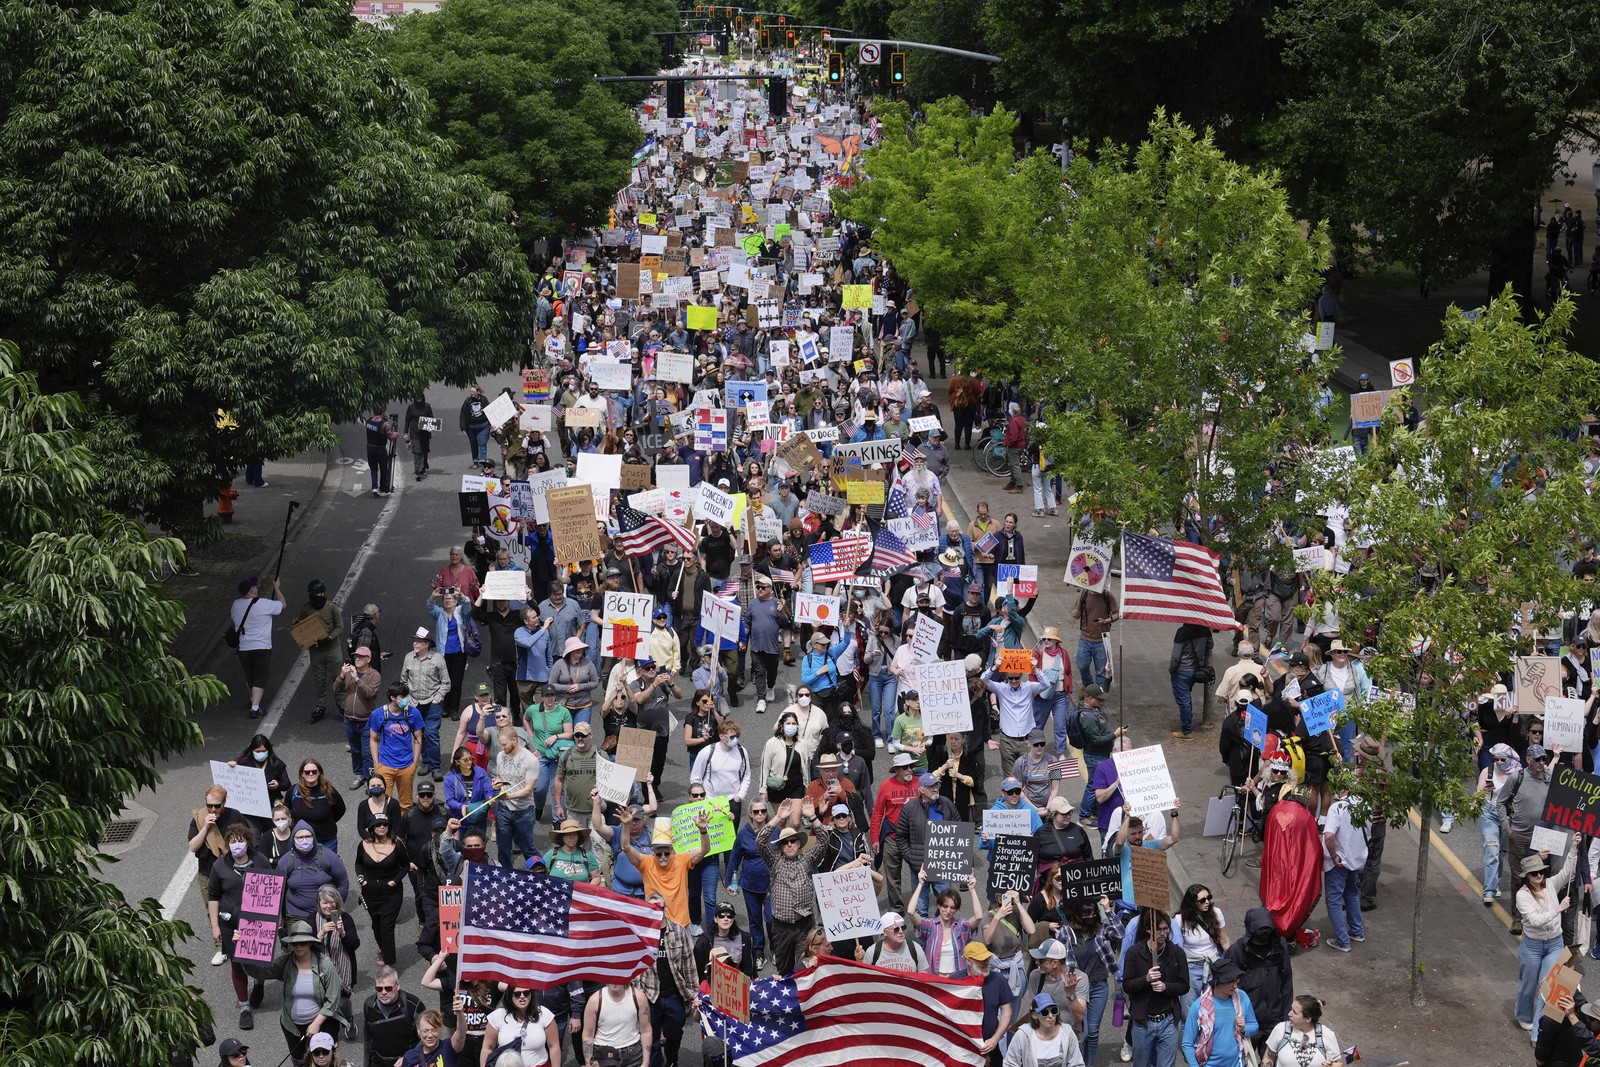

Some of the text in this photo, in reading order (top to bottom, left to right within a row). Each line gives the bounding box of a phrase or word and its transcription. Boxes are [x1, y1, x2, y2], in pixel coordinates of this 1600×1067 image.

[912, 422, 940, 431] KINGS
[818, 429, 836, 439] DOGE
[641, 434, 662, 448] ICE
[782, 436, 806, 454] NO KINGS
[861, 444, 900, 462] KINGS
[621, 468, 646, 478] Crush
[542, 479, 552, 488] NO
[554, 498, 586, 509] COMPASSION
[702, 487, 733, 510] CONCERNED
[704, 501, 725, 519] CITIZEN
[890, 515, 936, 532] NO KIS
[556, 540, 599, 561] NO KING
[1093, 548, 1111, 563] TARIFF
[1086, 553, 1099, 563] TACO
[1019, 583, 1033, 593] US
[607, 595, 650, 616] 8647
[816, 595, 834, 605] People
[704, 598, 734, 624] WTF
[920, 618, 936, 631] Prison
[920, 663, 956, 679] RESIST
[921, 679, 966, 693] REUNITE
[922, 693, 964, 707] REPEAT
[1310, 694, 1332, 708] Kings
[1547, 699, 1563, 710] Our
[1324, 702, 1341, 714] cards
[929, 709, 962, 722] Trump
[1549, 712, 1573, 721] Shared
[930, 722, 970, 734] Cruelty
[1547, 722, 1582, 734] HUMANITY
[625, 730, 650, 745] NO
[1119, 747, 1157, 759] DETHRONE
[1120, 764, 1166, 778] RESTORE OUR
[1130, 775, 1162, 785] SCIENCE,
[1126, 783, 1171, 796] DEMOCRACY,
[1144, 793, 1158, 802] AND
[1577, 796, 1586, 810] la
[1133, 800, 1173, 814] FREEDOM!!!
[712, 831, 724, 839] rules
[928, 837, 970, 847] MAKE ME
[928, 850, 963, 859] REPEAT
[996, 846, 1025, 856] Stranger
[1010, 854, 1033, 863] invited
[936, 873, 971, 882] -HISTOR
[1066, 863, 1120, 882] NO HUMAN
[251, 874, 279, 886] CANCEL
[818, 871, 867, 888] I KNEW
[992, 872, 1030, 891] JESUS
[245, 883, 281, 896] DARK KING
[820, 882, 870, 897] IT WOULD
[1066, 881, 1123, 899] IS ILLEGAL
[251, 895, 274, 908] THIEL
[844, 894, 866, 904] BAD
[829, 917, 856, 936] HOLY
[259, 929, 275, 939] HORSE
[241, 939, 273, 956] PALANTIR
